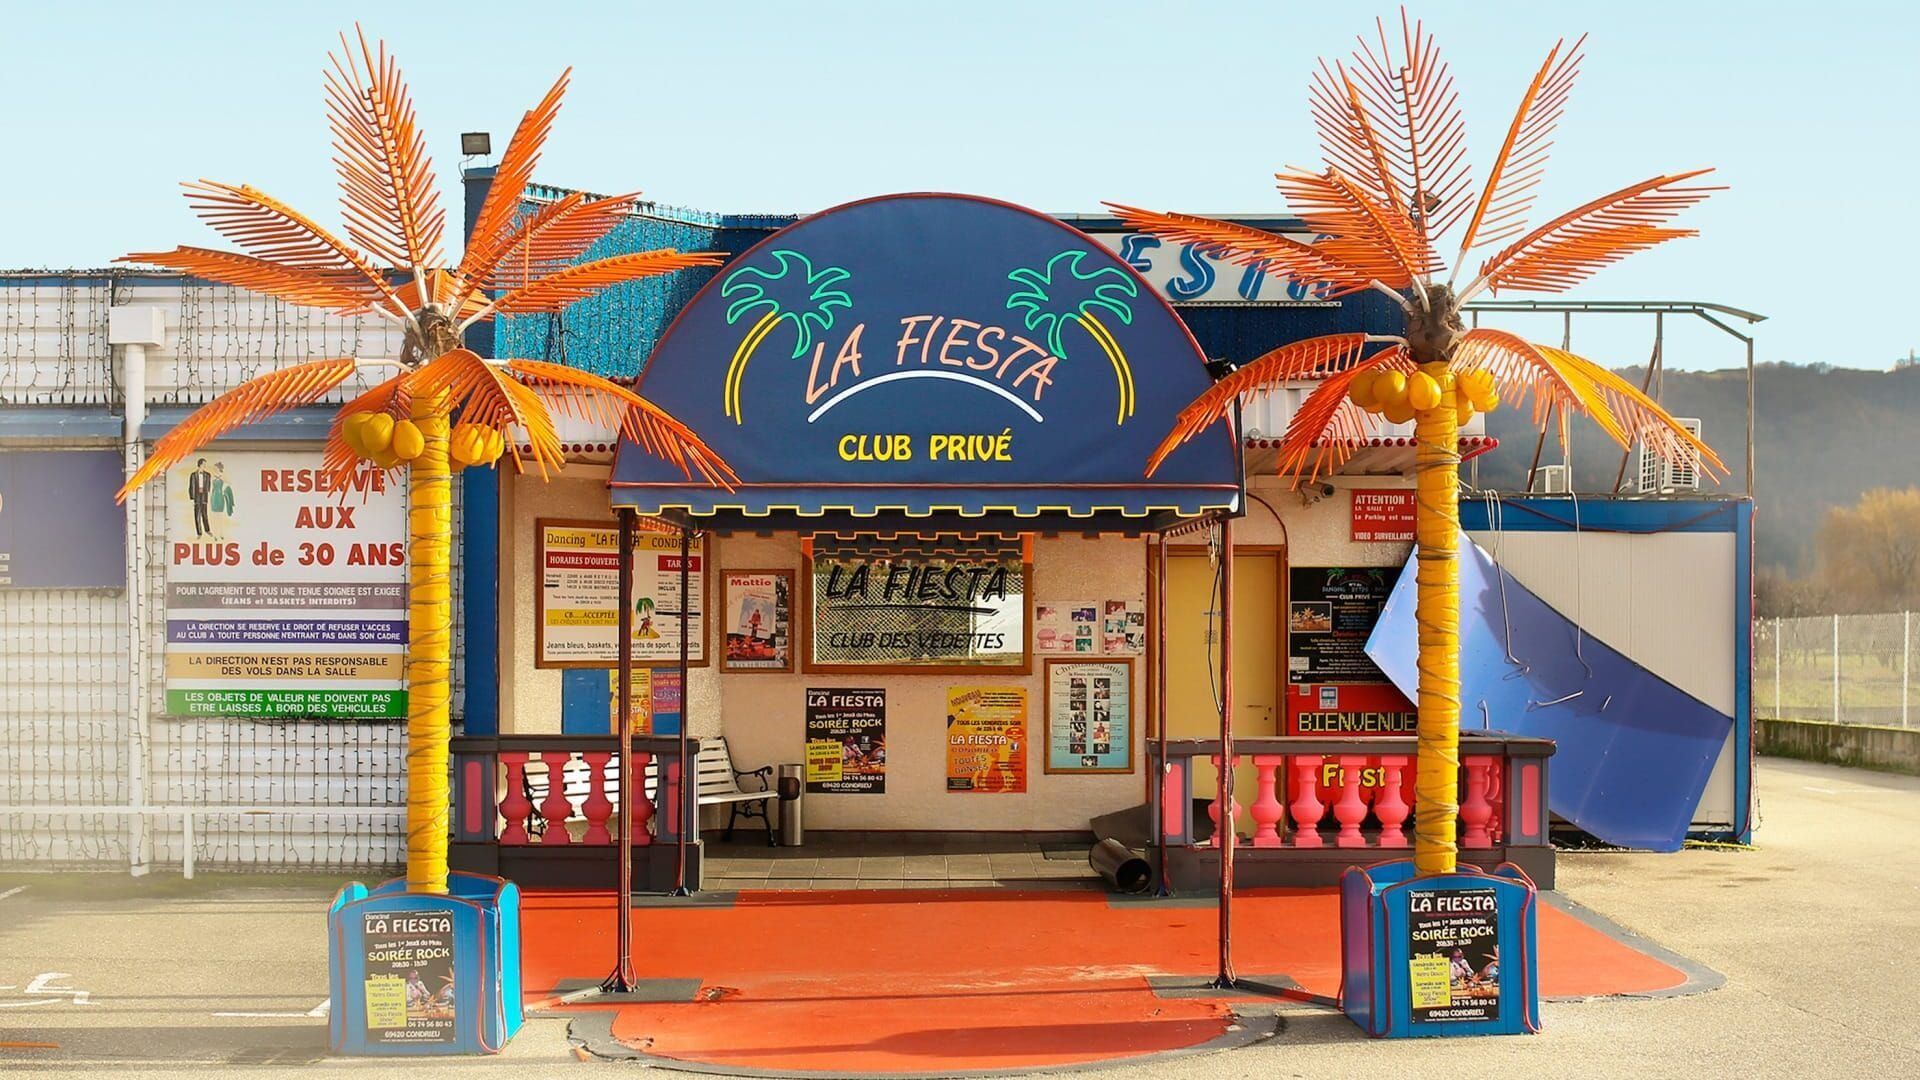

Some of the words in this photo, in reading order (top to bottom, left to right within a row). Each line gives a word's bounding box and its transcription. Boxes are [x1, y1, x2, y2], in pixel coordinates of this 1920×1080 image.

[806, 323, 864, 405] LA
[897, 315, 1059, 400] FIESTA
[838, 434, 912, 462] CLUB
[928, 427, 1013, 462] PRIVÉ
[1355, 494, 1405, 505] ATTENTION
[295, 506, 355, 529] AUX
[1364, 514, 1386, 522] Parking
[547, 533, 585, 548] Dancing
[651, 537, 699, 549] CONDEU
[1354, 531, 1371, 540] VIDEO
[1374, 531, 1414, 541] SURVEILLANCE
[174, 543, 240, 566] PLUS
[252, 542, 285, 566] de
[298, 543, 334, 566] 30
[347, 543, 405, 566] ANS
[550, 555, 583, 565] HORAIRES
[666, 559, 692, 568] TARS
[731, 578, 772, 586] Mattio
[826, 564, 870, 600] LA
[884, 563, 1009, 602] FIESTA
[176, 586, 196, 596] POUR
[198, 586, 244, 596] L'AGREMENT
[246, 586, 256, 596] DE
[259, 586, 278, 596] TOUS
[280, 586, 295, 596] UNE
[298, 586, 321, 596] TENUE
[323, 586, 356, 596] SOIGNEE
[358, 586, 372, 596] EST
[374, 586, 400, 596] EXIGEE
[222, 597, 251, 605] (JEANS
[309, 597, 356, 605] INTERDITS)
[187, 623, 197, 631] LA
[200, 623, 235, 631] DIRECTION
[237, 623, 246, 631] SE
[249, 623, 280, 631] RESERVE
[282, 623, 291, 631] LE
[293, 623, 314, 631] DROIT
[317, 623, 326, 631] DE
[328, 623, 359, 631] REFUSER
[361, 623, 391, 631] L'ACCES
[281, 632, 320, 640] N'ENTRANT
[322, 632, 335, 640] PAS
[338, 632, 357, 640] DANS
[360, 632, 375, 640] SON
[376, 632, 400, 640] CADRE
[830, 632, 874, 649] CLUB
[879, 632, 912, 649] DES
[919, 632, 1005, 649] VEDETTES
[546, 641, 566, 649] Jeans
[566, 641, 586, 650] bleus,
[587, 641, 613, 650] baskets,
[646, 641, 654, 649] de
[189, 656, 202, 665] LA
[206, 656, 258, 665] DIRECTION
[262, 656, 289, 665] N'EST
[293, 657, 312, 666] PAS
[315, 657, 388, 666] RESPONSABLE
[222, 667, 242, 675] DES
[246, 667, 272, 675] VOLS
[276, 667, 304, 675] DANS
[307, 667, 321, 676] LA
[325, 667, 357, 676] SALLE
[185, 692, 204, 702] LES
[207, 692, 246, 702] OBJETS
[250, 692, 263, 702] DE
[267, 692, 304, 702] VALEUR
[307, 693, 321, 703] NE
[324, 693, 369, 703] DOIVENT
[372, 693, 391, 703] PAS
[808, 695, 828, 707] LA
[831, 695, 884, 707] FIESTA
[190, 703, 216, 712] ETRE
[219, 703, 262, 712] LAISSES
[265, 703, 273, 712] A
[276, 703, 304, 712] BORD
[307, 703, 328, 712] DES
[331, 703, 387, 713] VEHICULES
[809, 717, 850, 729] SOIRÉE
[852, 718, 882, 728] ROCK
[1299, 712, 1417, 731] BIENVENUE
[950, 735, 965, 745] LA
[968, 735, 1007, 745] FIESTA
[1411, 897, 1432, 912] LA
[1436, 895, 1495, 912] FIESTA
[366, 919, 388, 934] LA
[392, 918, 451, 933] FIESTA
[1412, 925, 1457, 941] SOIRÉE
[1460, 925, 1494, 938] ROCK
[368, 946, 413, 962] SOIRÉE
[416, 947, 450, 960] ROCK
[406, 1030, 441, 1038] CONDRIEU
